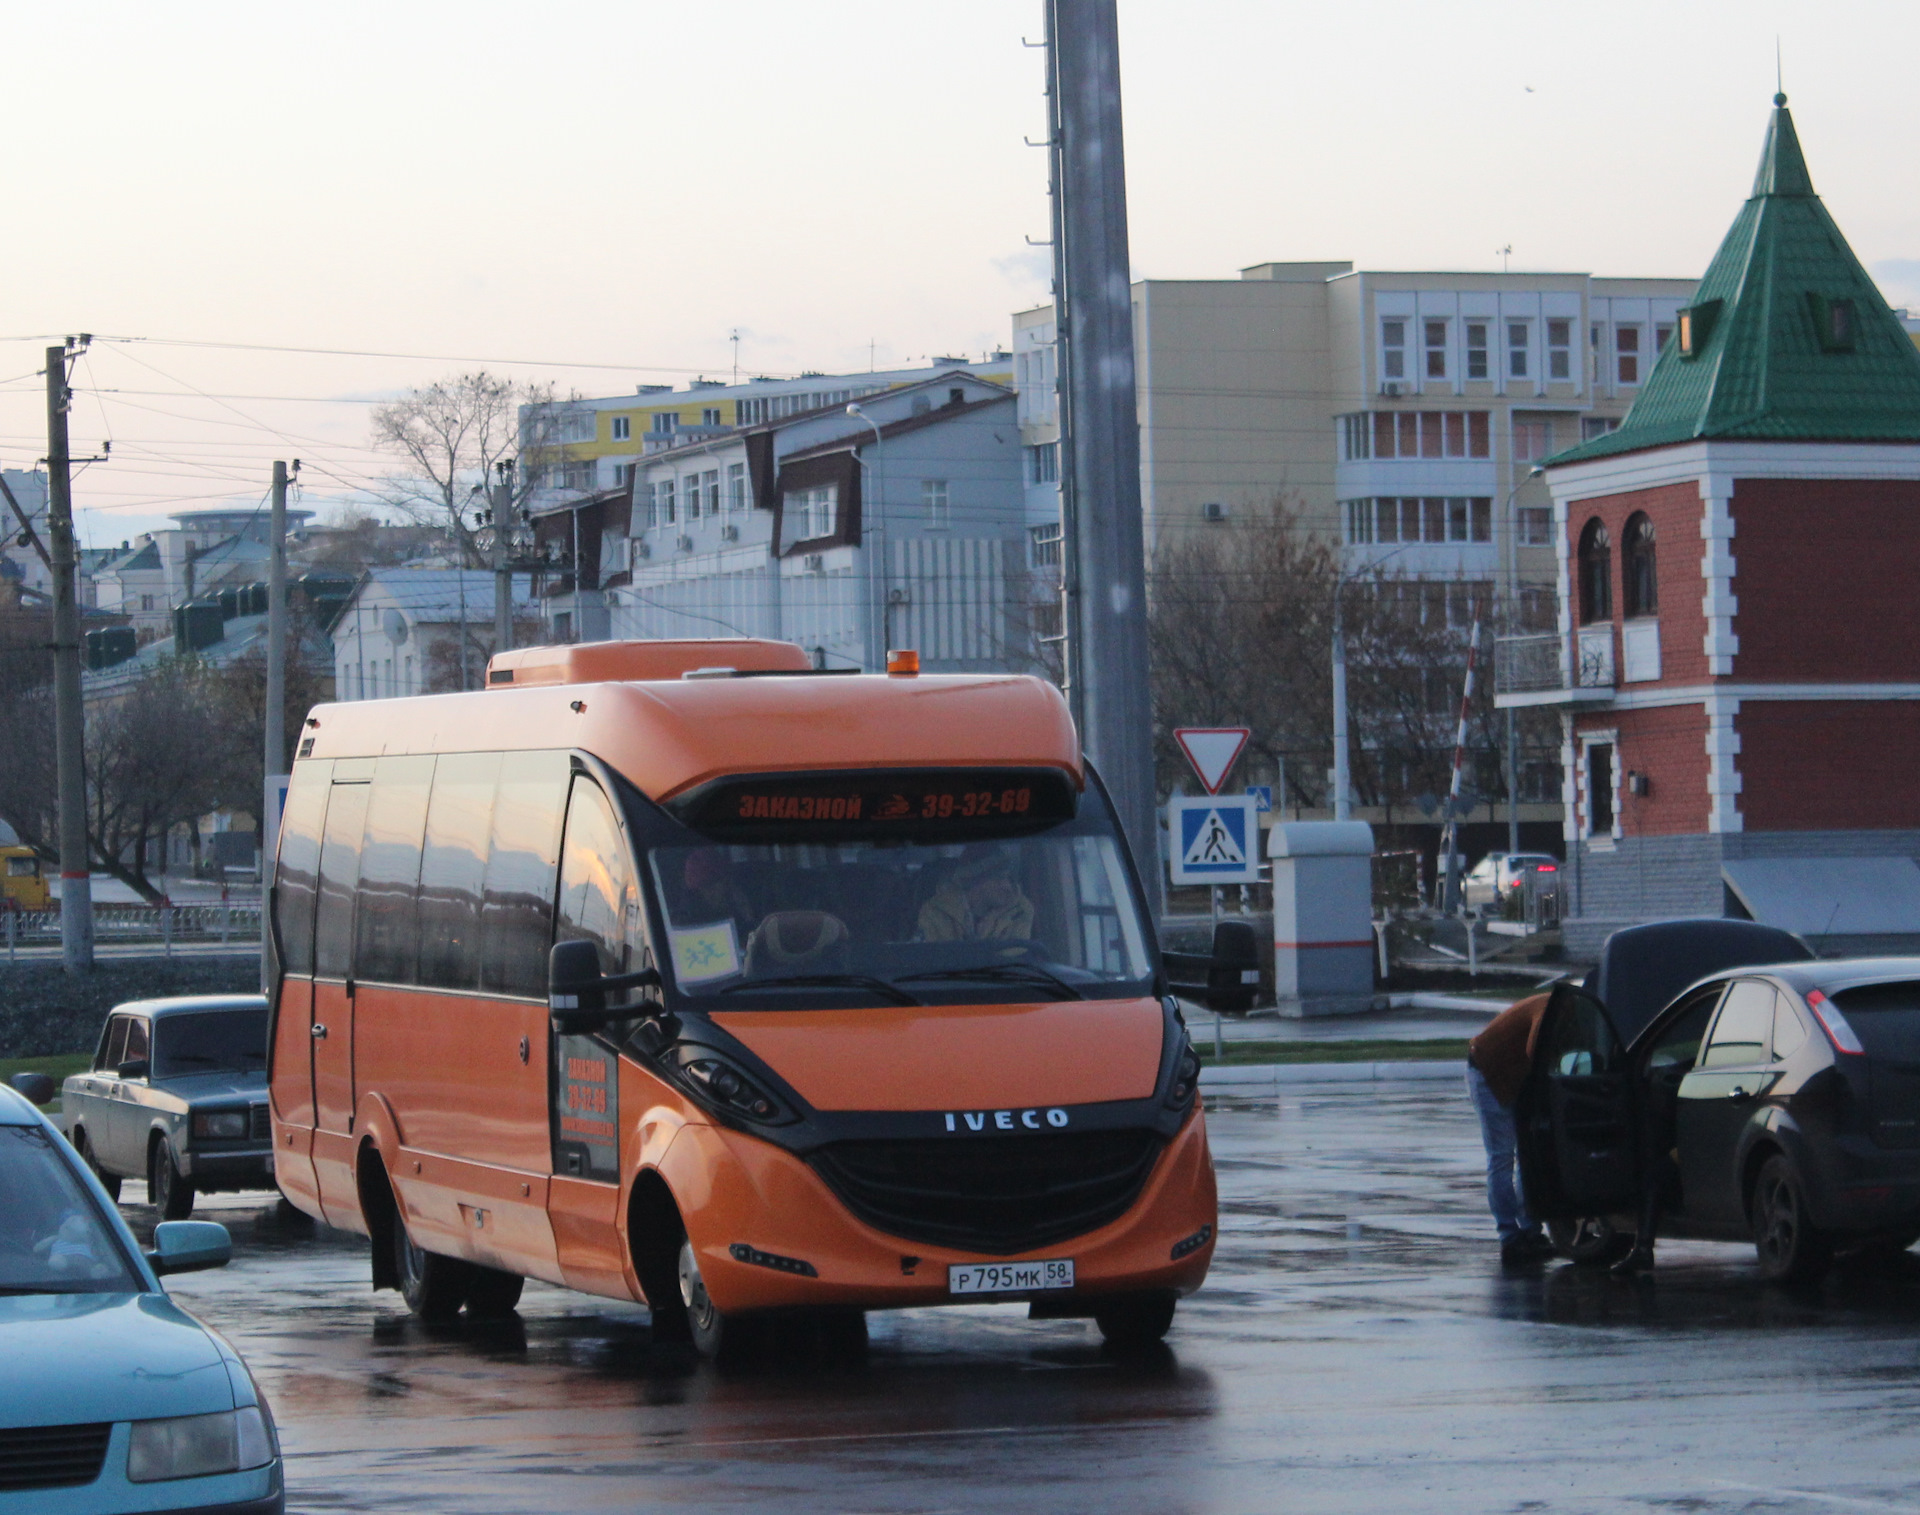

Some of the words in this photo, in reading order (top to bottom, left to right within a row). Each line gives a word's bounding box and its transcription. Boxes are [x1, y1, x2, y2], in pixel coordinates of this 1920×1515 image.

[739, 794, 862, 819] ЗАКАЗНОЙ
[922, 788, 1031, 818] 39-32-69
[944, 1109, 1069, 1131] IVECO
[1047, 1263, 1066, 1279] 58
